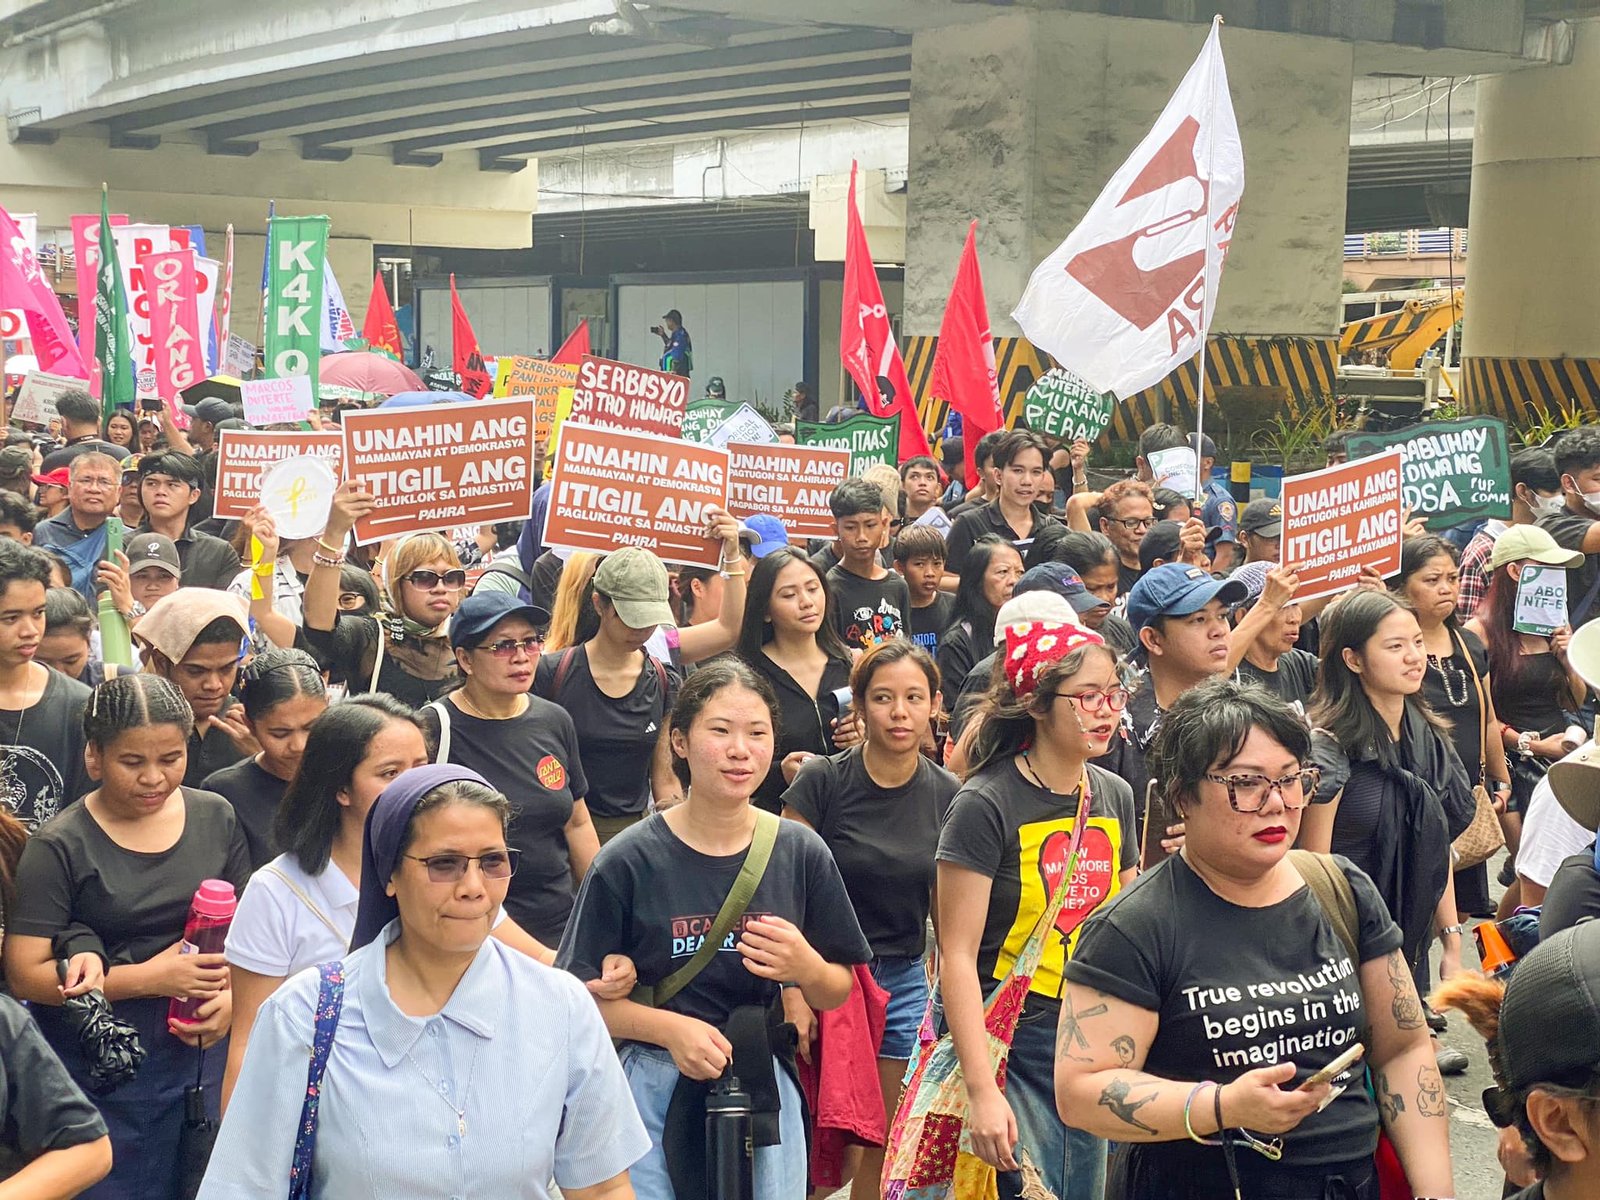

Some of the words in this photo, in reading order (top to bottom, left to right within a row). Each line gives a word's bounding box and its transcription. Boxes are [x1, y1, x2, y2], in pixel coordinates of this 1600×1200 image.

[515, 359, 577, 380] SERBISYON
[581, 361, 685, 407] SERBISYO
[573, 389, 594, 412] SA
[630, 399, 684, 428] HUWAG
[1026, 385, 1110, 426] MUKANG
[352, 422, 463, 453] UNAHIN
[470, 416, 526, 441] ANG
[853, 426, 891, 452] ITAAS
[1386, 427, 1487, 465] SABUHAY
[226, 444, 300, 459] UNAHIN
[303, 444, 342, 458] ANG
[355, 450, 431, 465] MAMAMAYAN
[434, 448, 449, 458] AT
[450, 438, 525, 455] DEMOKRASYA
[565, 441, 668, 476] UNAHIN
[673, 459, 723, 486] ANG
[730, 453, 800, 474] UNAHIN
[804, 460, 844, 477] ANG
[356, 466, 450, 496] ITIGIL
[459, 455, 526, 485] ANG
[563, 464, 635, 484] MAMAMAYAN
[636, 475, 651, 485] AT
[652, 477, 722, 497] DEMOKRASYA
[730, 469, 776, 481] PAGTUGON
[776, 472, 790, 482] SA
[1406, 459, 1452, 483] DIWA
[1454, 453, 1482, 476] NG
[375, 492, 436, 509] GLUKLOK
[439, 490, 456, 501] SA
[459, 481, 525, 499] DINASTIYA
[557, 481, 648, 517] ITIGIL
[728, 482, 789, 504] ITIGIL
[1288, 480, 1360, 517] UNAHIN
[1363, 469, 1397, 498] ANG
[418, 505, 466, 521] PAHRA
[557, 506, 632, 527] PAGLUKLOK
[635, 519, 651, 530] SA
[729, 500, 770, 512] PAGPABOR
[771, 504, 784, 514] SA
[785, 506, 834, 518] MAYAYAMA
[1288, 508, 1339, 530] PAGTUGON
[1340, 504, 1353, 516] SA
[1353, 491, 1398, 513] KAHIRAPAN
[612, 532, 659, 549] PAHRA
[1288, 524, 1352, 562] ITIGIL
[1357, 509, 1398, 544] ANG
[1337, 549, 1349, 561] SA
[1350, 534, 1398, 558] MAYAYAMAN
[1329, 563, 1362, 582] PAHRA
[1071, 873, 1088, 885] DS
[1077, 860, 1110, 873] MORE
[1083, 886, 1100, 898] TO
[673, 932, 735, 955] DEAR
[1182, 986, 1242, 1011] True
[1203, 1005, 1296, 1040] begins
[1302, 998, 1327, 1021] in
[1333, 989, 1360, 1015] the
